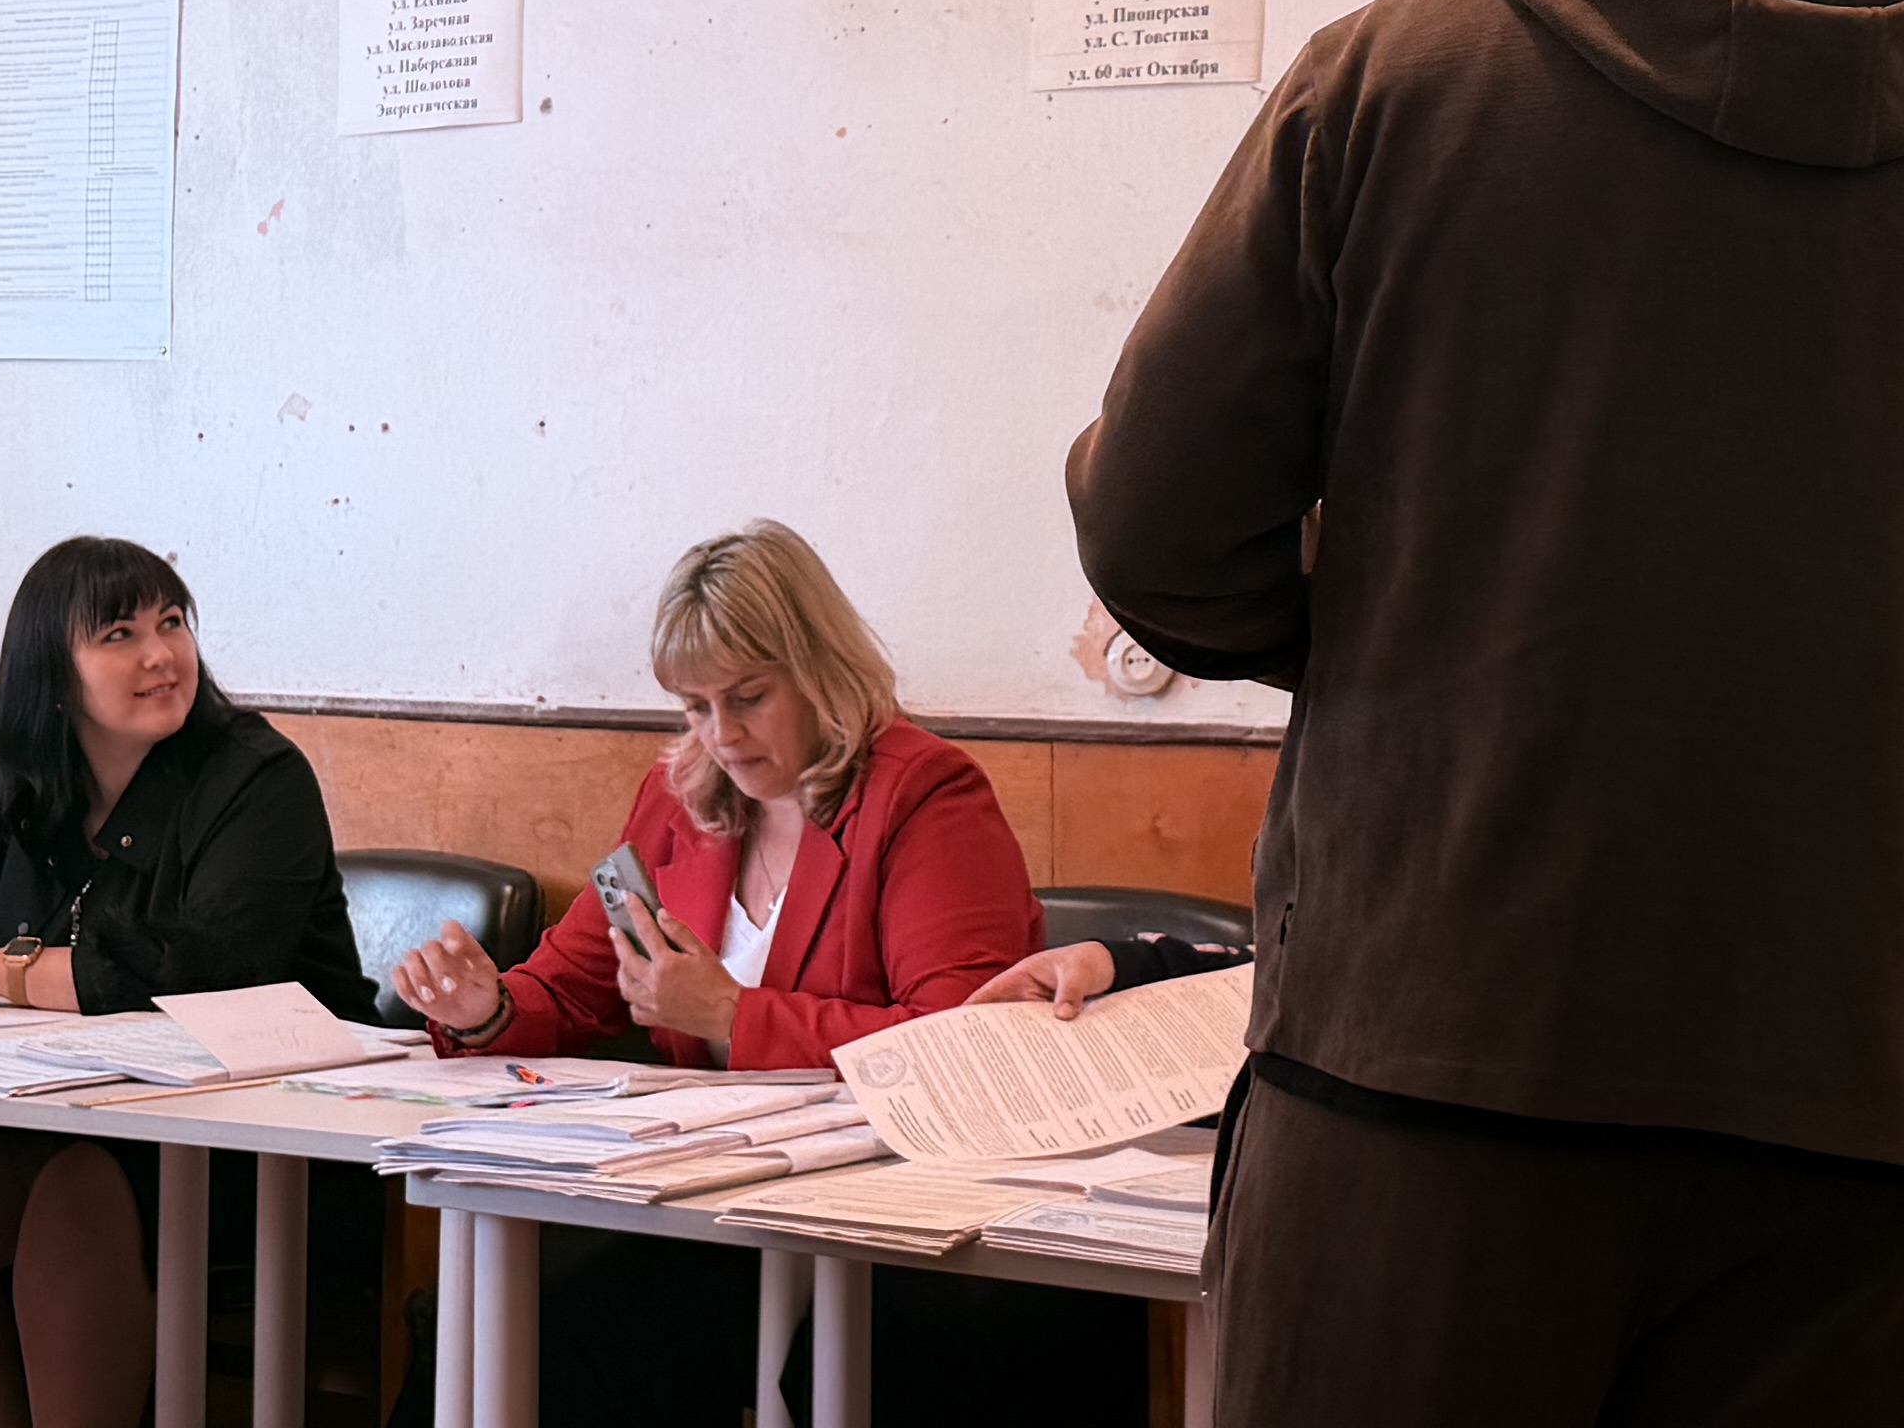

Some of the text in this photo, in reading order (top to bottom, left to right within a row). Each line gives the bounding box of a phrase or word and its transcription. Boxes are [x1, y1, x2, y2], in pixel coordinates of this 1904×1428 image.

[410, 14, 470, 32] Заречная
[1085, 4, 1210, 29] ул. Пионерская
[1084, 28, 1209, 53] ул. С. Товстика
[1068, 59, 1219, 85] ул. 60 лет Октября
